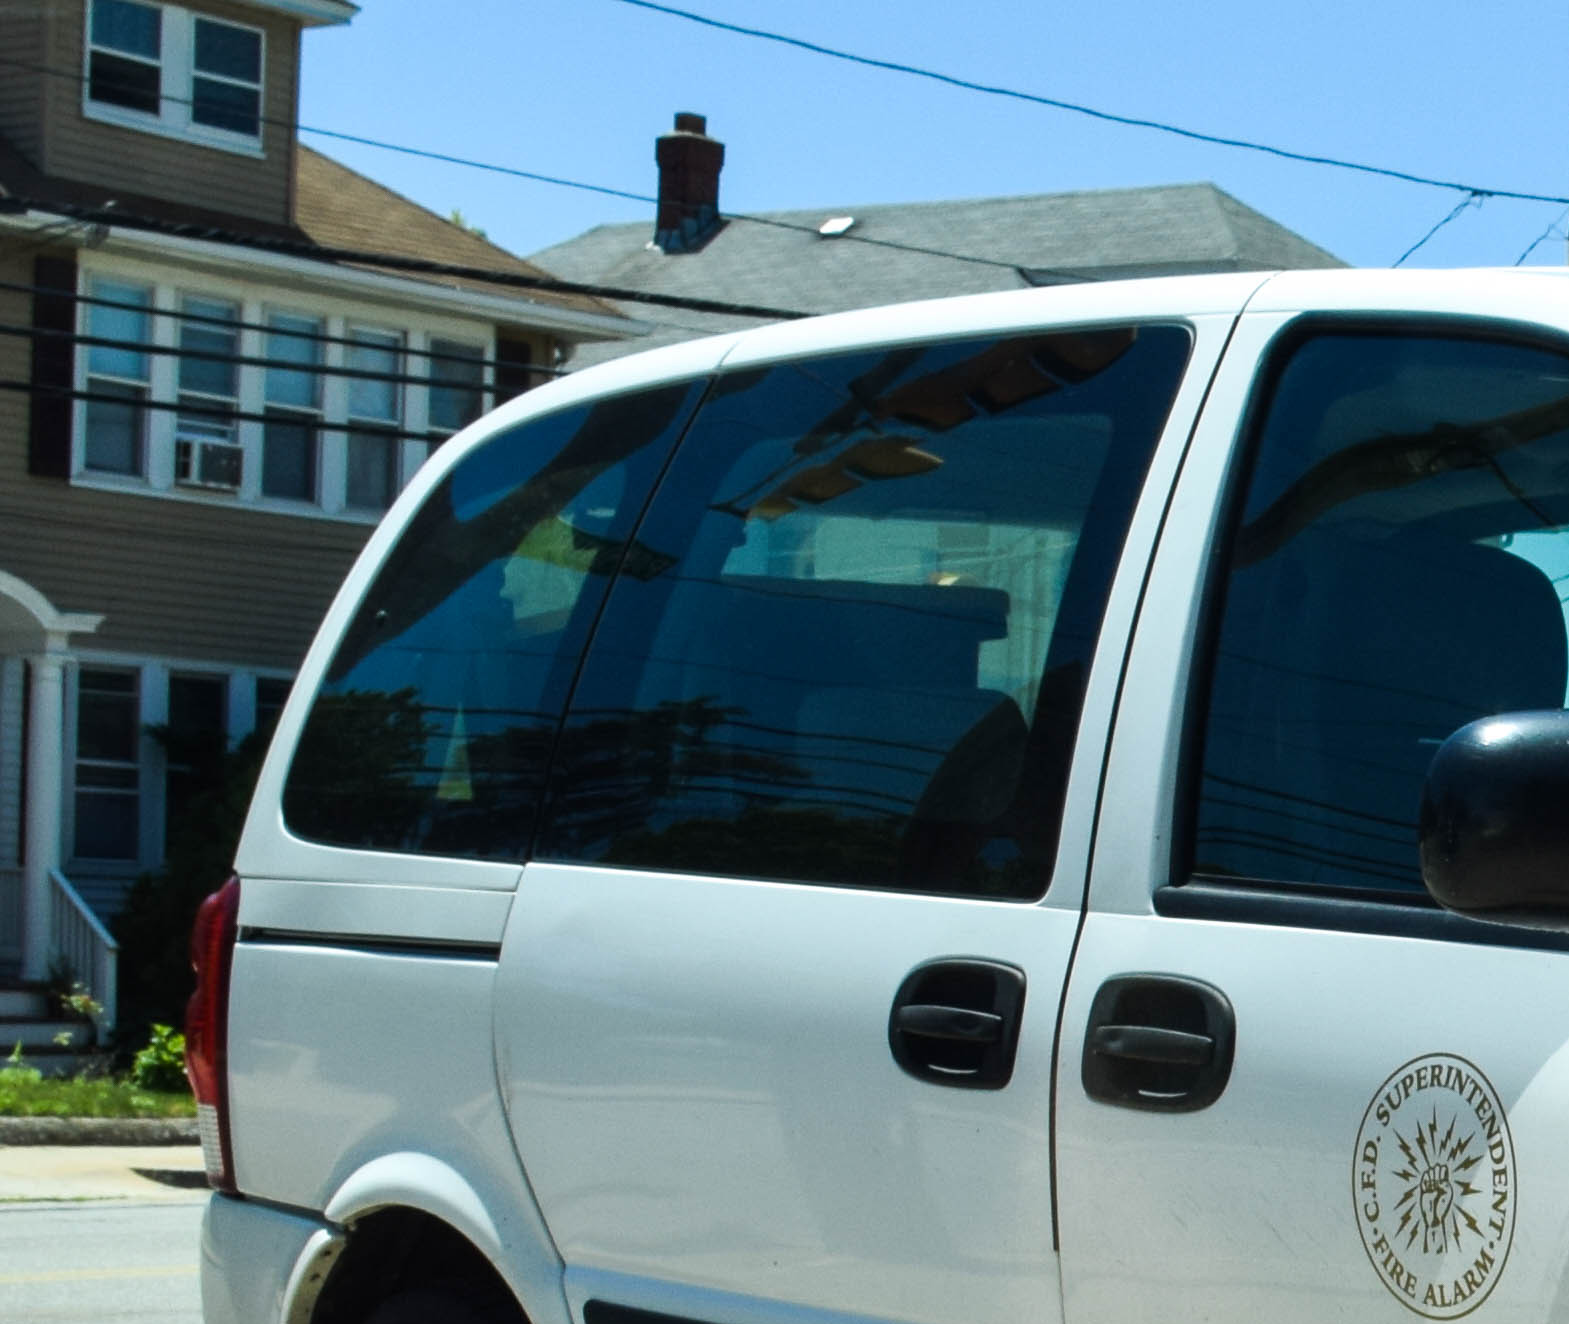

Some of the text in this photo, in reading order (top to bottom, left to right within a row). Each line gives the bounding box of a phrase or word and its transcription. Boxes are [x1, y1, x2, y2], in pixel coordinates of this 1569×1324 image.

[1361, 1064, 1508, 1241] C.F.D. SUPERINTENDENT
[1372, 1233, 1496, 1308] FIRE ALARM
